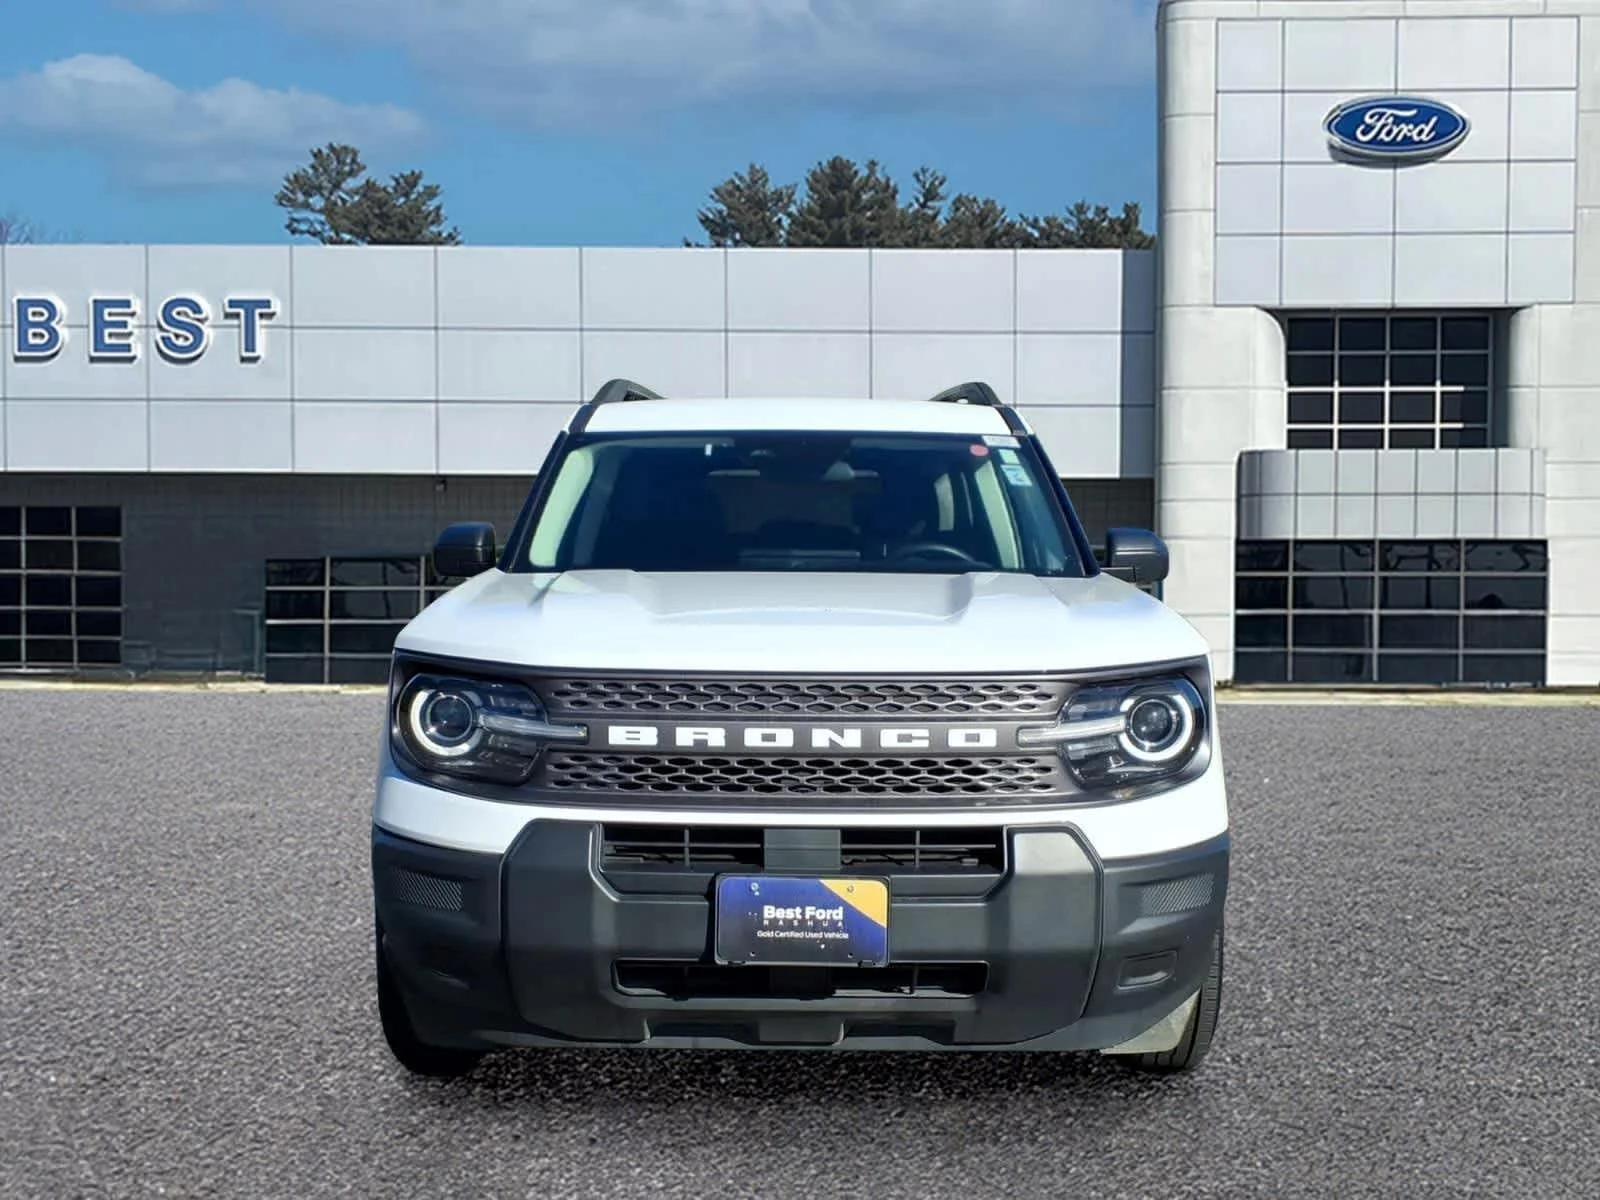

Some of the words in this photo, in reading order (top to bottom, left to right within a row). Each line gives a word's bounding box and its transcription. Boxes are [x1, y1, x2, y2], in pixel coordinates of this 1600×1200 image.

[1355, 107, 1438, 142] Ford
[13, 296, 277, 363] BEST
[607, 725, 998, 749] BRONCO
[763, 905, 802, 919] Best
[805, 906, 843, 920] Ford
[757, 930, 774, 938] Gold
[775, 930, 804, 939] Certified
[805, 930, 823, 939] Used
[824, 931, 849, 939] Vehicle
